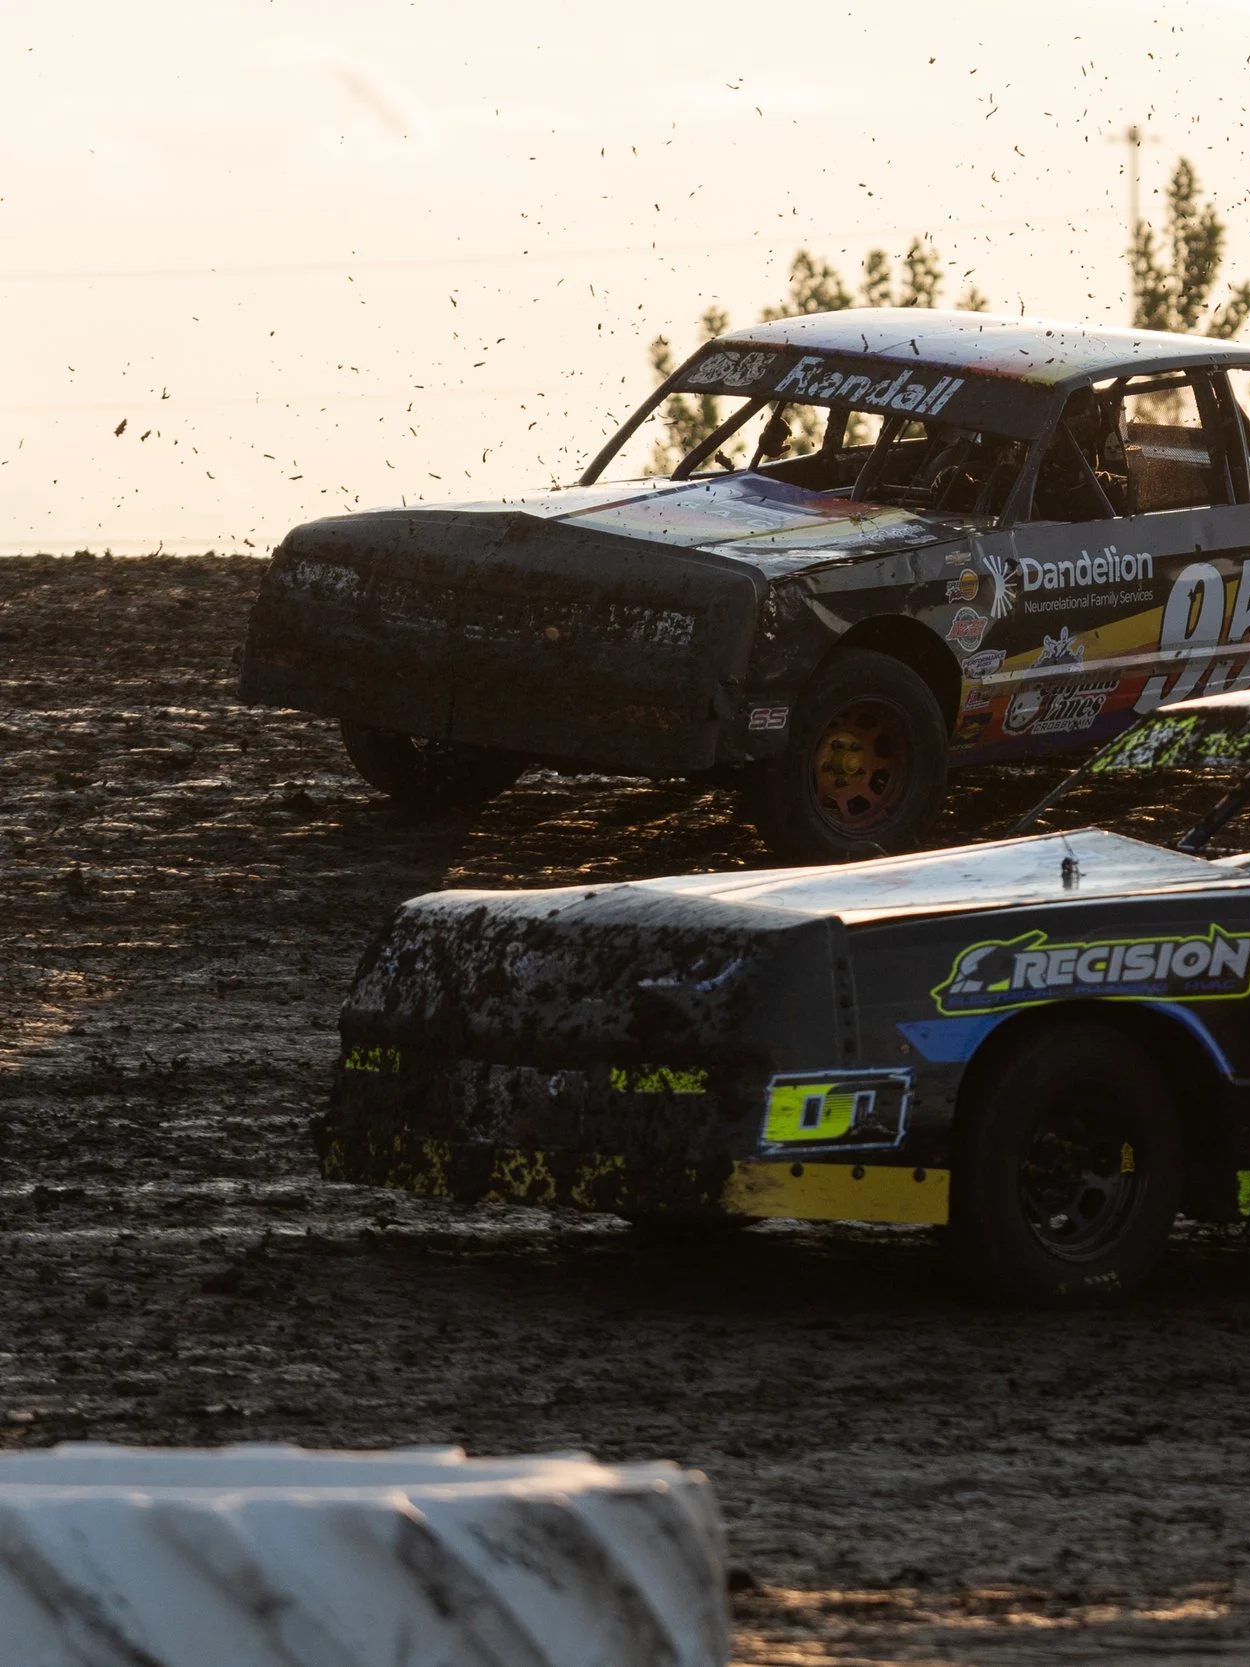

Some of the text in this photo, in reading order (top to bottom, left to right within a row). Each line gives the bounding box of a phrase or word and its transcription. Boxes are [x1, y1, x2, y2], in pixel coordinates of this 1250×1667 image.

[774, 355, 965, 416] Randall
[1020, 546, 1153, 591] Dandelion
[1024, 588, 1154, 613] Neurorelational Family Services
[749, 707, 788, 730] SS
